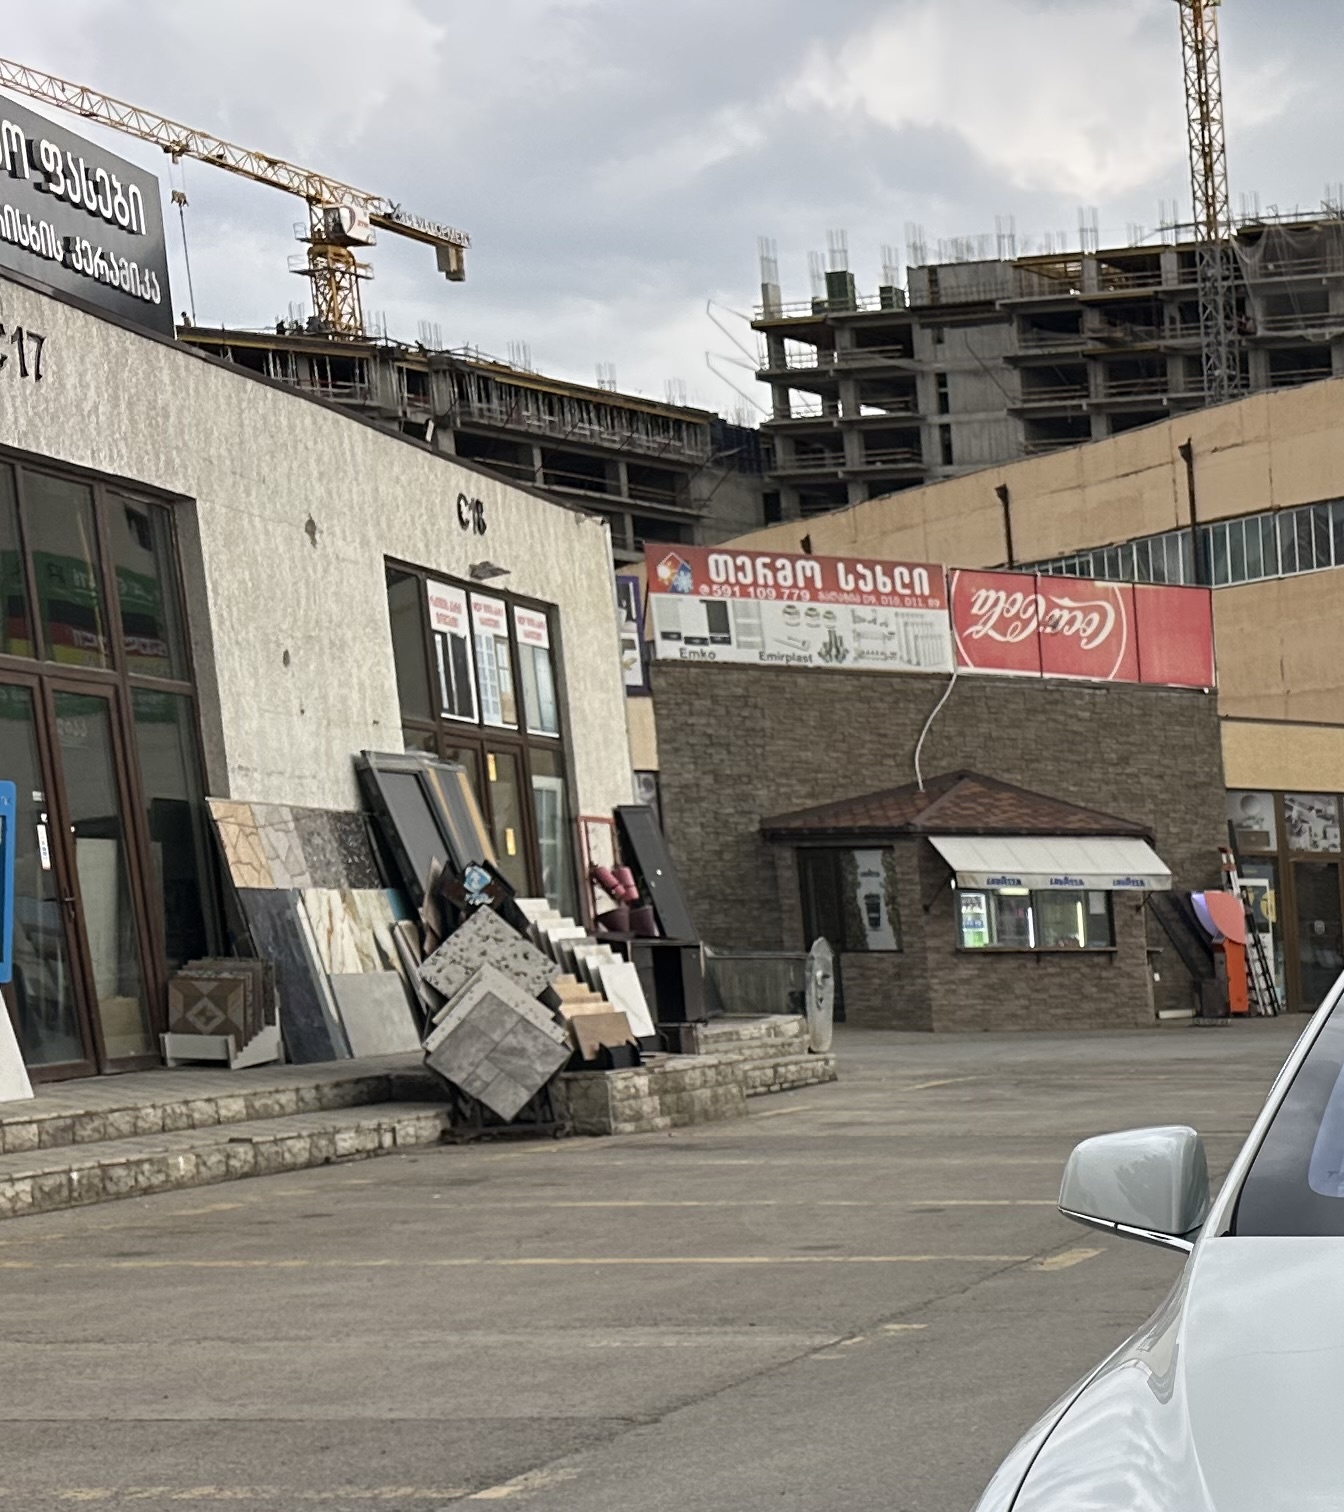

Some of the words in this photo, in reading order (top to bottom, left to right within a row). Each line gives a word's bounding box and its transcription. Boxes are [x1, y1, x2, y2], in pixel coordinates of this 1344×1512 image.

[40, 139, 147, 235] ფასები
[0, 204, 64, 263] ისხის
[72, 235, 161, 305] კერამიკა
[457, 493, 488, 536] C18
[707, 552, 822, 590] თერმო
[836, 561, 930, 597] სახლი
[711, 585, 741, 598] 591
[749, 587, 777, 600] 109
